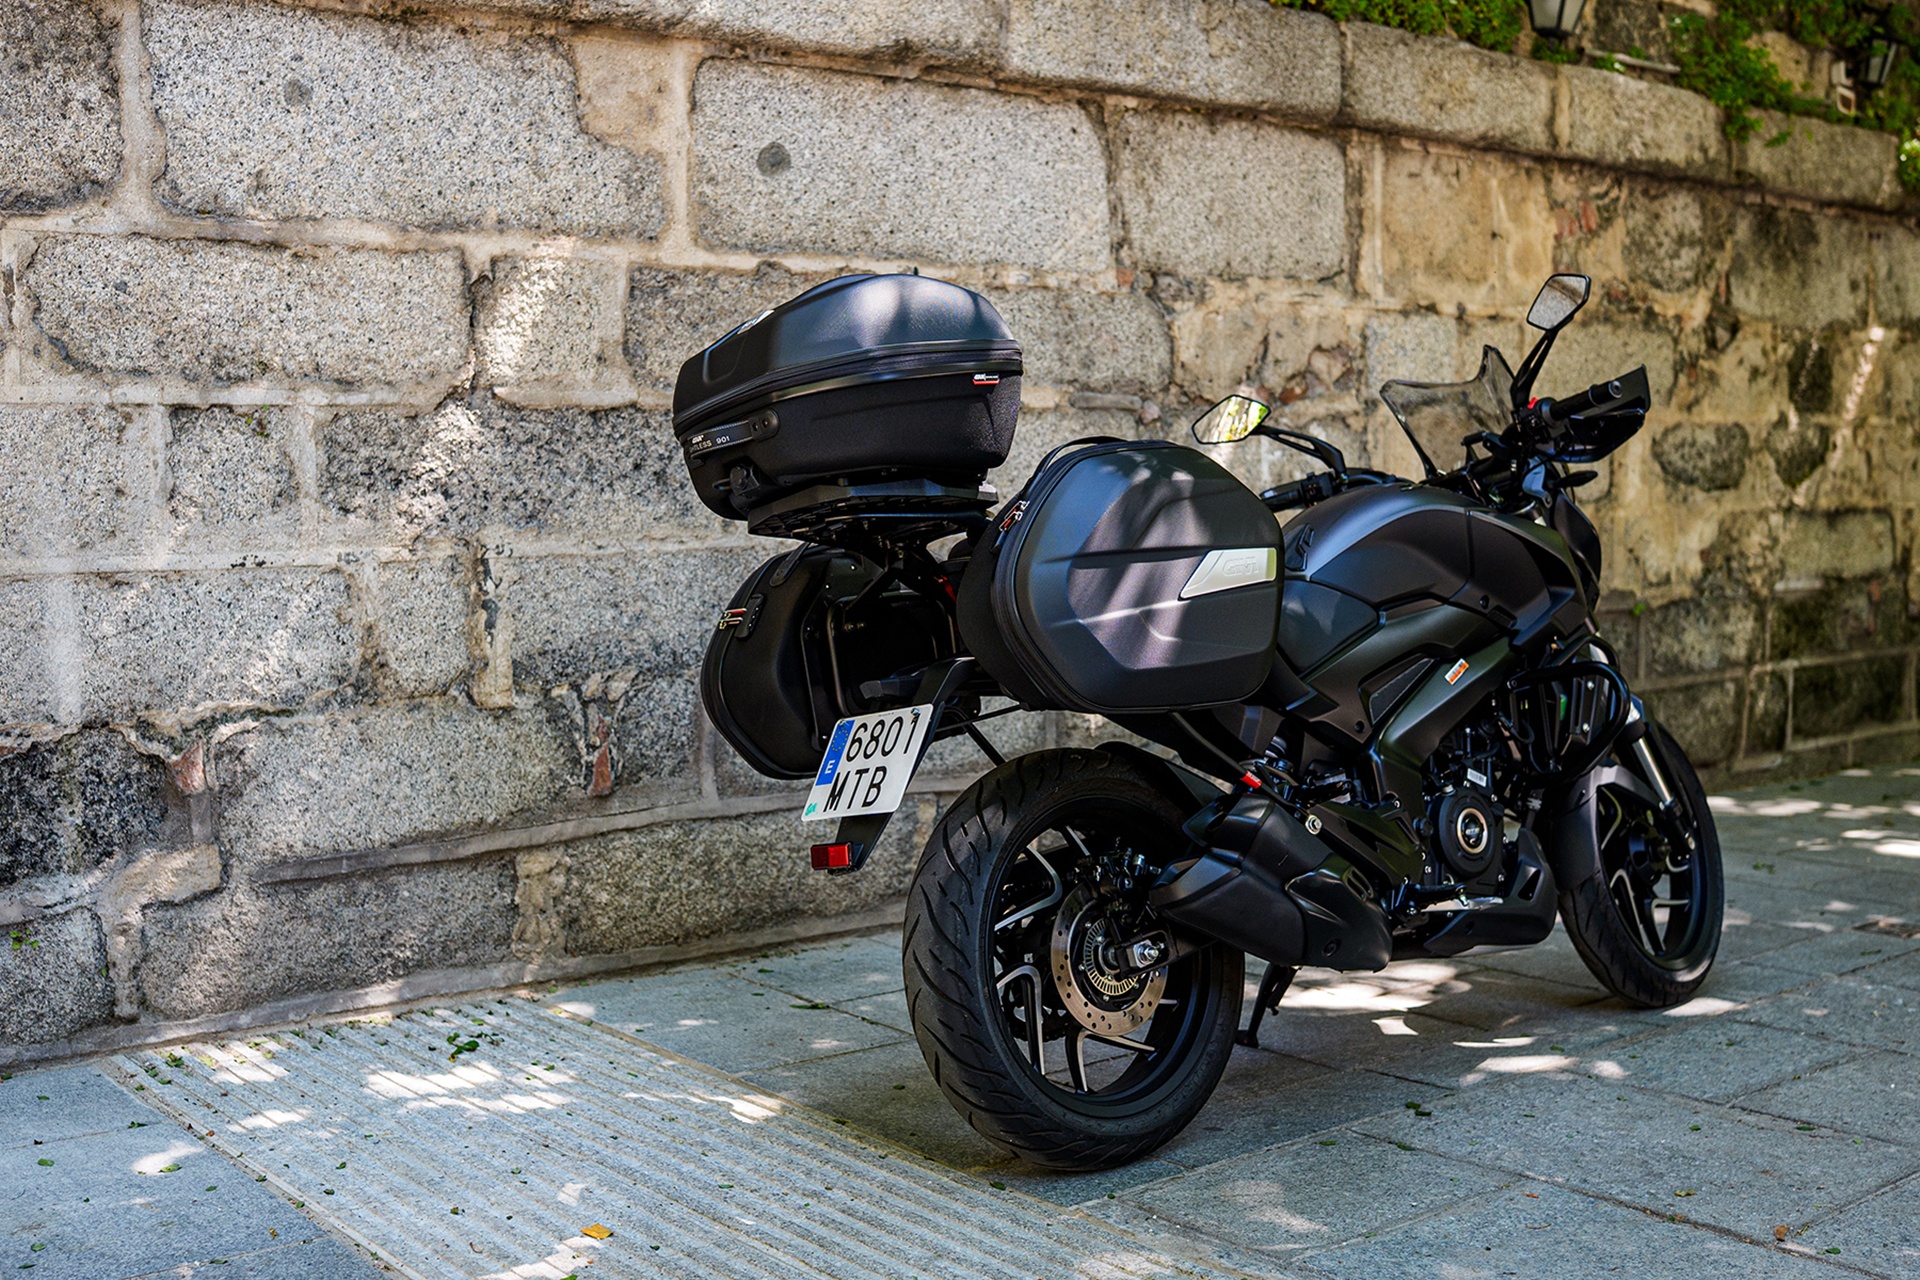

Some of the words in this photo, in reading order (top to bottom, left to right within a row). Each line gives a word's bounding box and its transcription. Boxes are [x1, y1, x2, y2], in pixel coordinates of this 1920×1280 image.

[716, 435, 730, 445] 901
[846, 714, 920, 763] 6801
[824, 760, 836, 775] E
[823, 765, 888, 812] MTB
